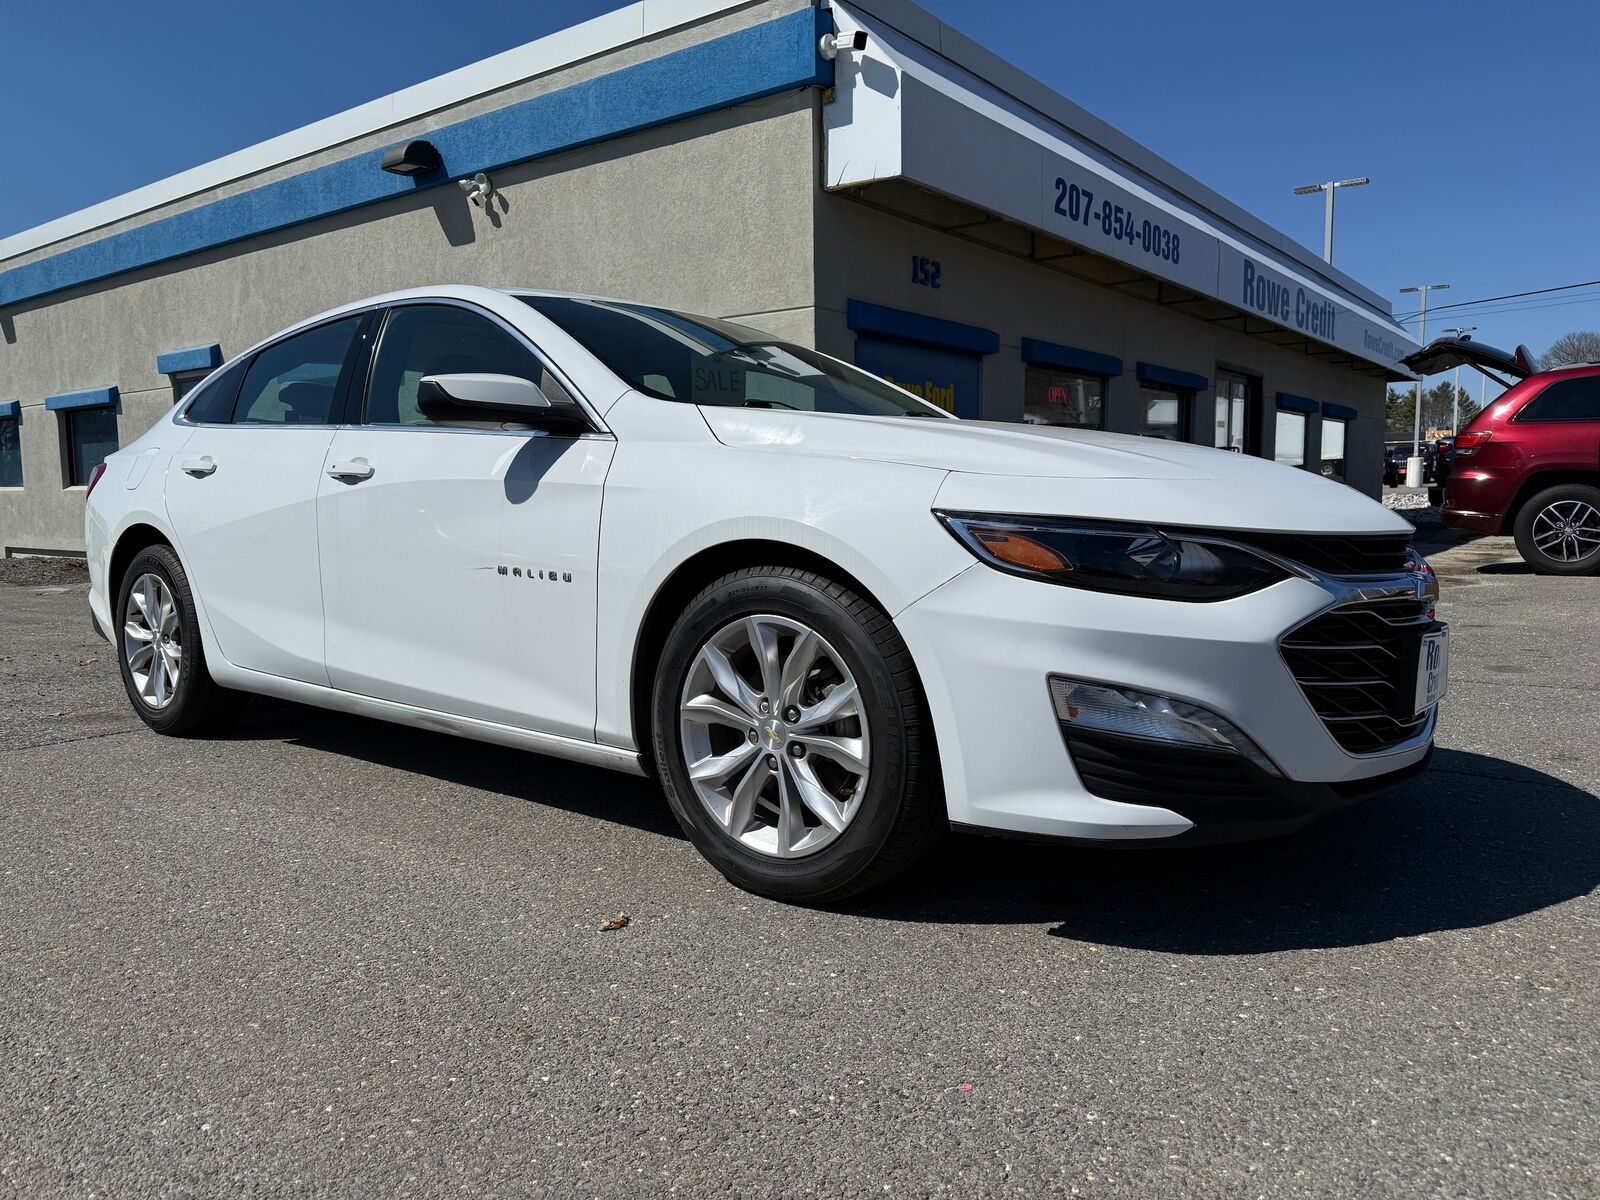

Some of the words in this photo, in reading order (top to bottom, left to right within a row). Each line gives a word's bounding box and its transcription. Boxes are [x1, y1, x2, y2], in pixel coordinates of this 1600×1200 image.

[1054, 177, 1180, 265] 207-854-0038
[911, 255, 942, 289] 152
[1242, 257, 1290, 322] Rowe
[1295, 287, 1336, 341] Credit
[695, 367, 739, 392] SALE
[497, 565, 572, 583] MALIBU
